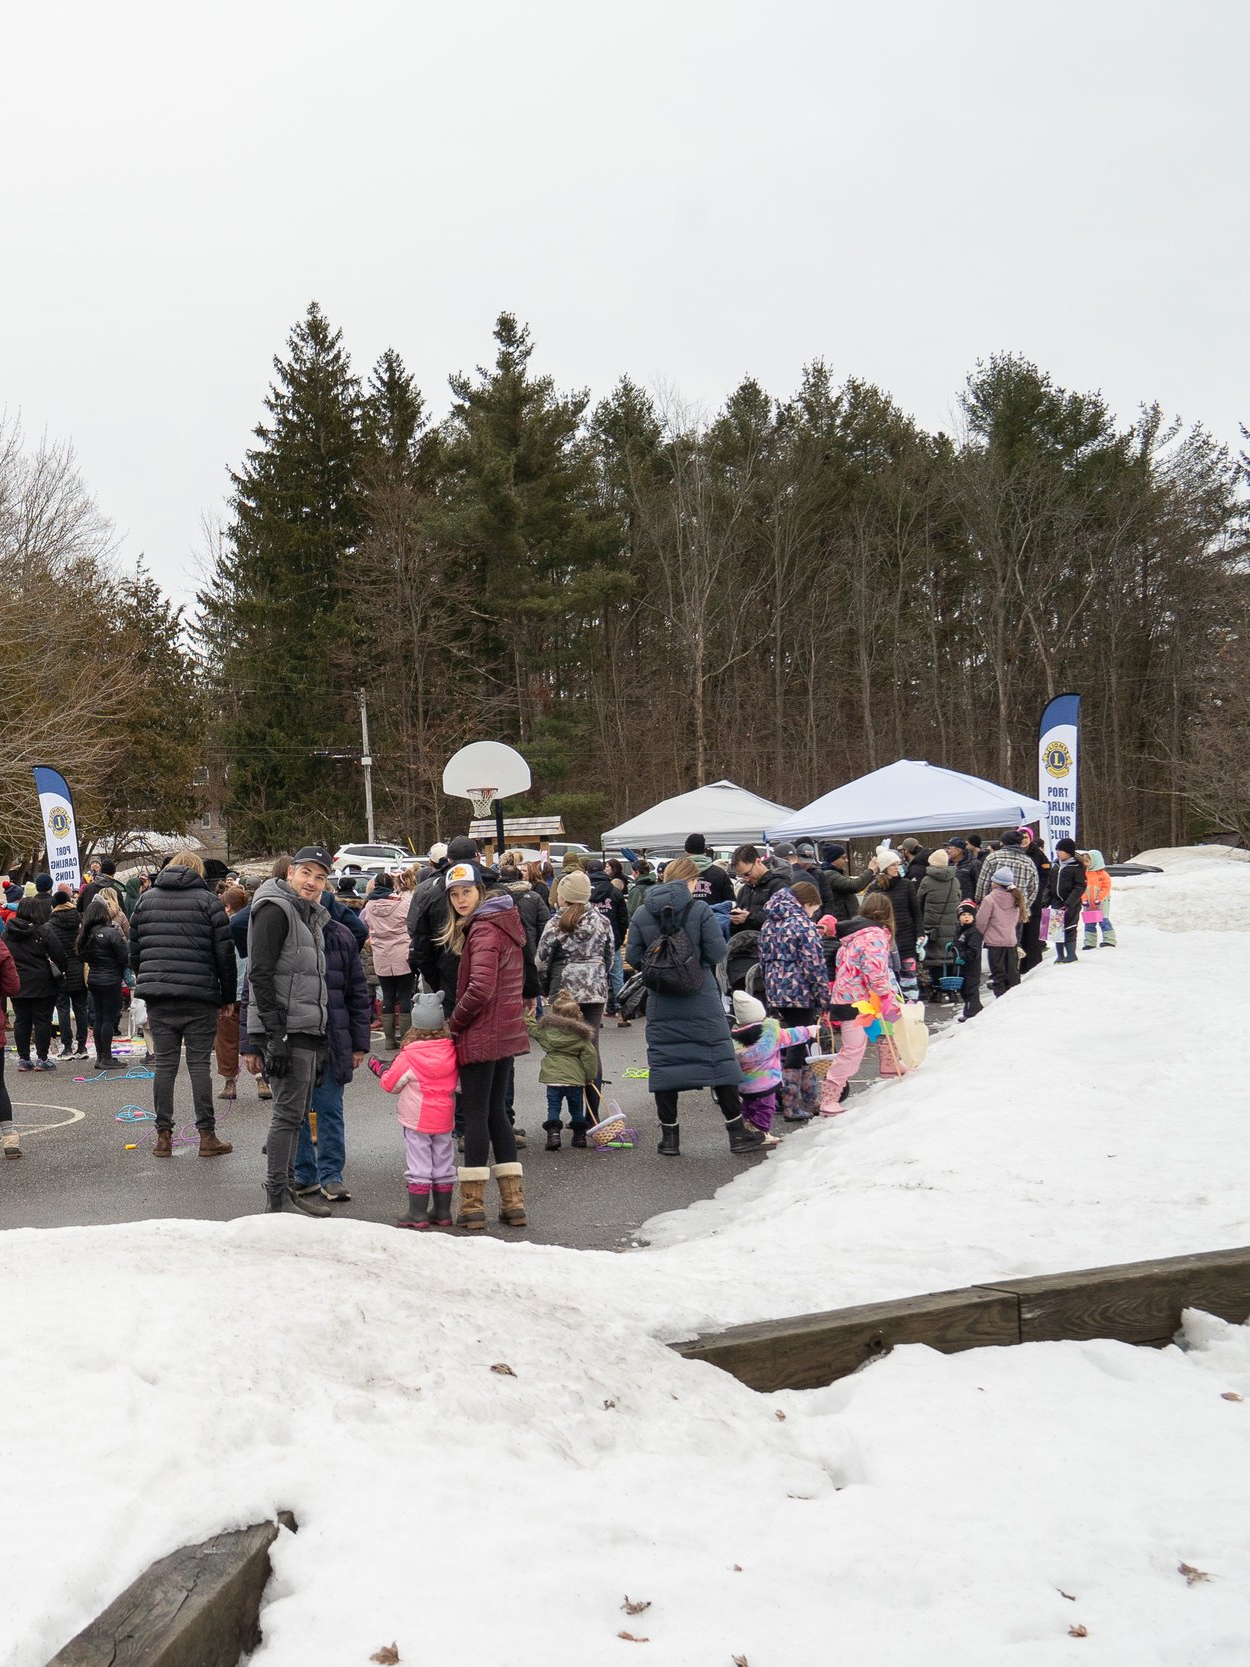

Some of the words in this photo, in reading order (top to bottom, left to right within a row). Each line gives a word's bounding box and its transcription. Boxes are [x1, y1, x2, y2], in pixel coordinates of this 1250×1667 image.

[1053, 753, 1063, 766] L
[1047, 786, 1069, 798] PORT
[1042, 800, 1075, 812] ARLING
[1050, 815, 1071, 826] IONS
